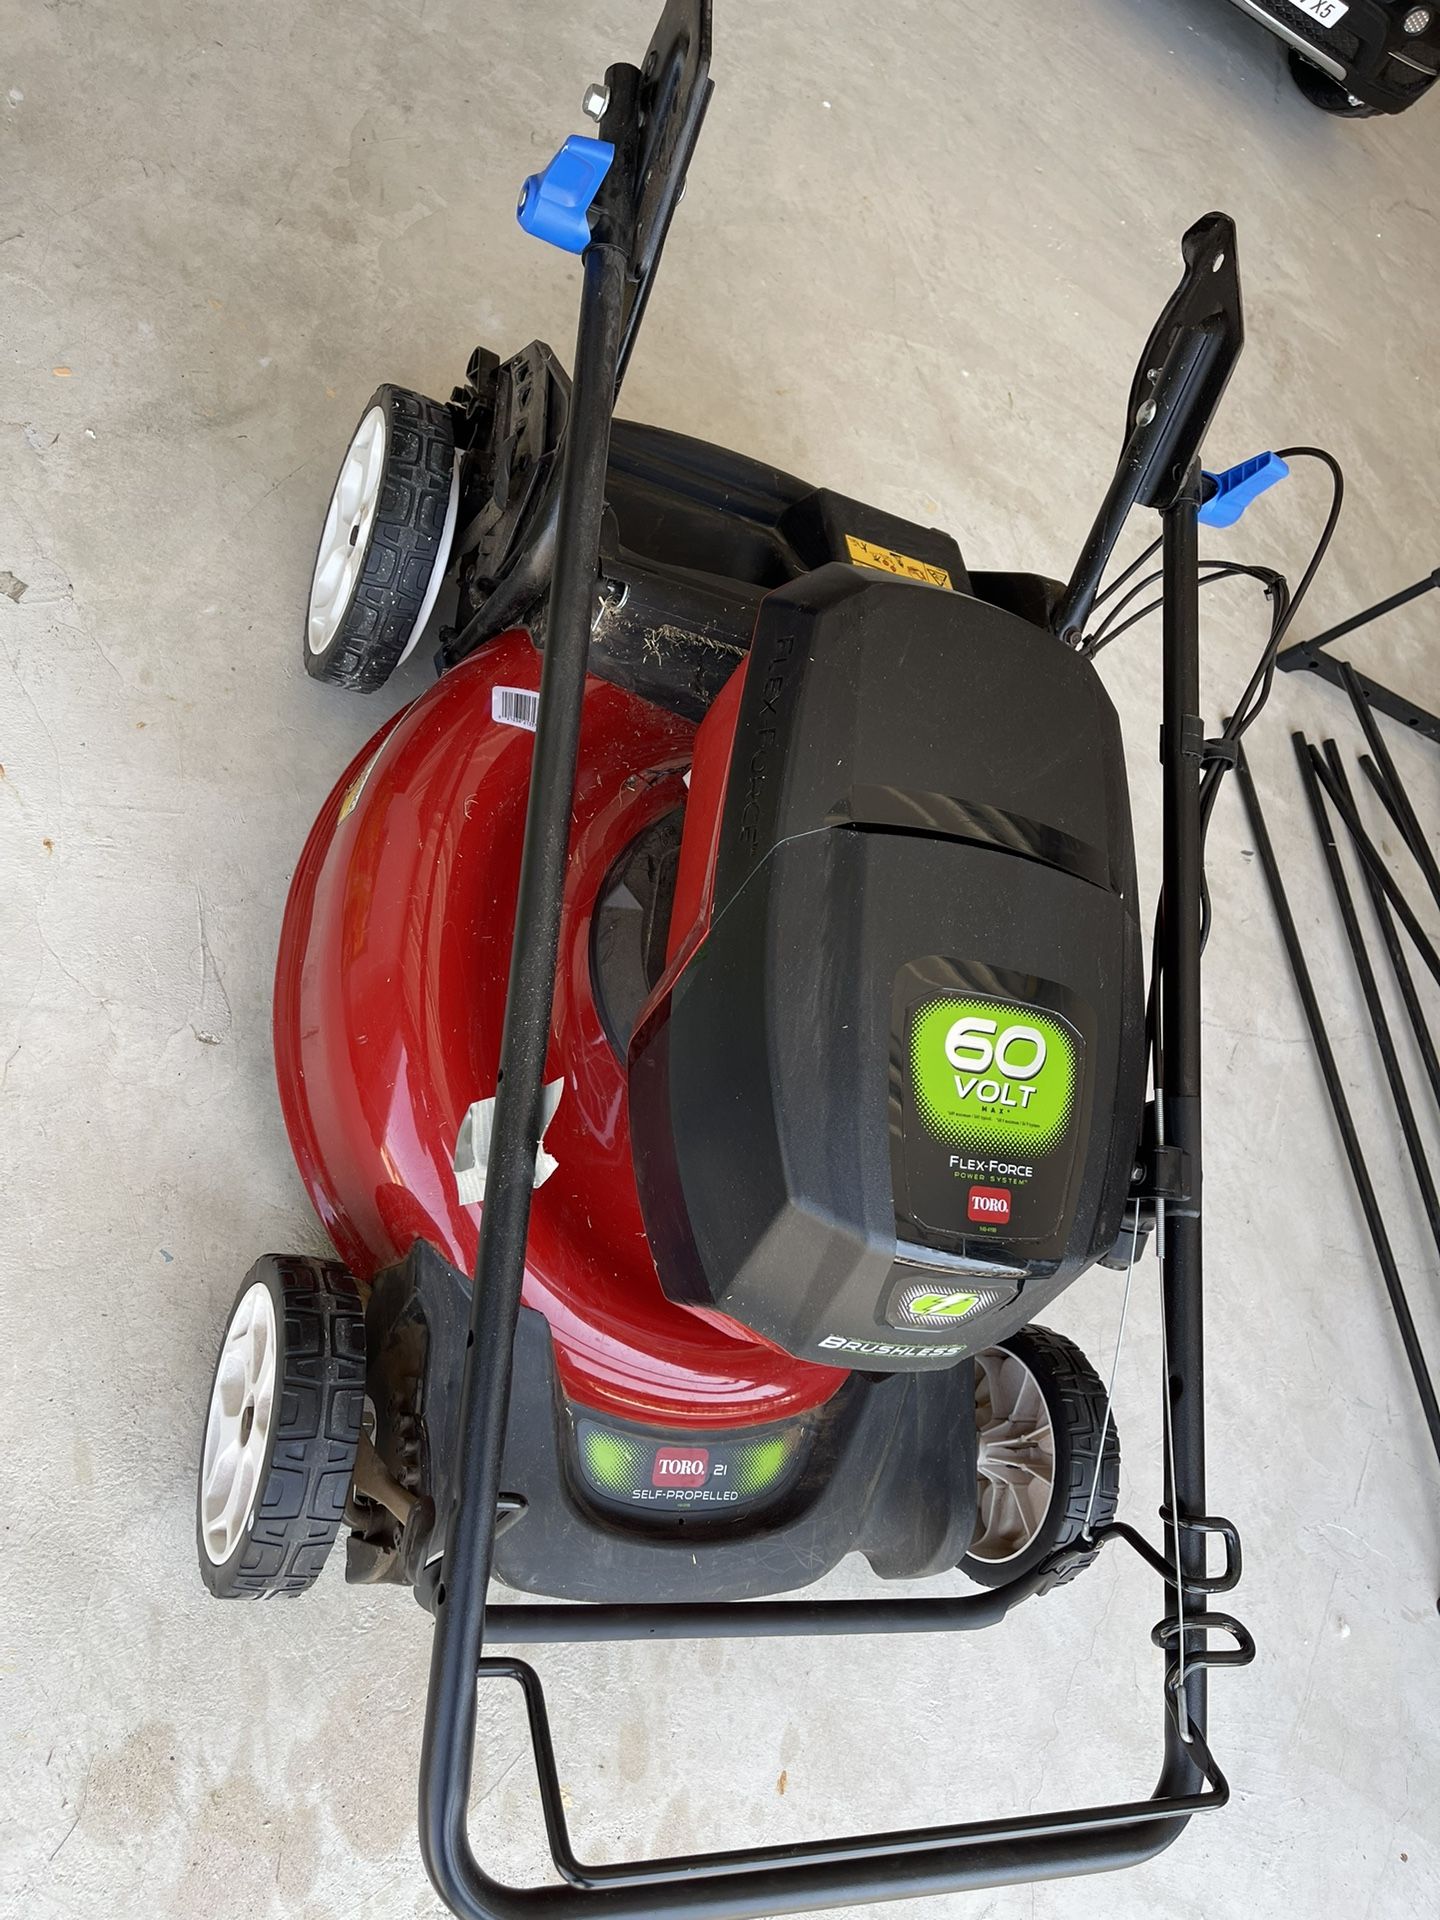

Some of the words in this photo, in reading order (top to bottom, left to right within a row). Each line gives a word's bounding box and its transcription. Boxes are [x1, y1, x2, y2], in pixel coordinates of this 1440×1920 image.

[1309, 0, 1336, 18] X5
[944, 1016, 1047, 1080] 60
[953, 1075, 1037, 1109] VOLT
[949, 1155, 1034, 1178] FLEX-FORCE
[953, 1171, 985, 1181] POWER
[972, 1196, 1009, 1213] TORO
[818, 1335, 963, 1357] BRUSHLESS
[658, 1459, 705, 1475] TORO
[713, 1464, 728, 1476] 21
[632, 1489, 739, 1501] SELF-PROPELLED
